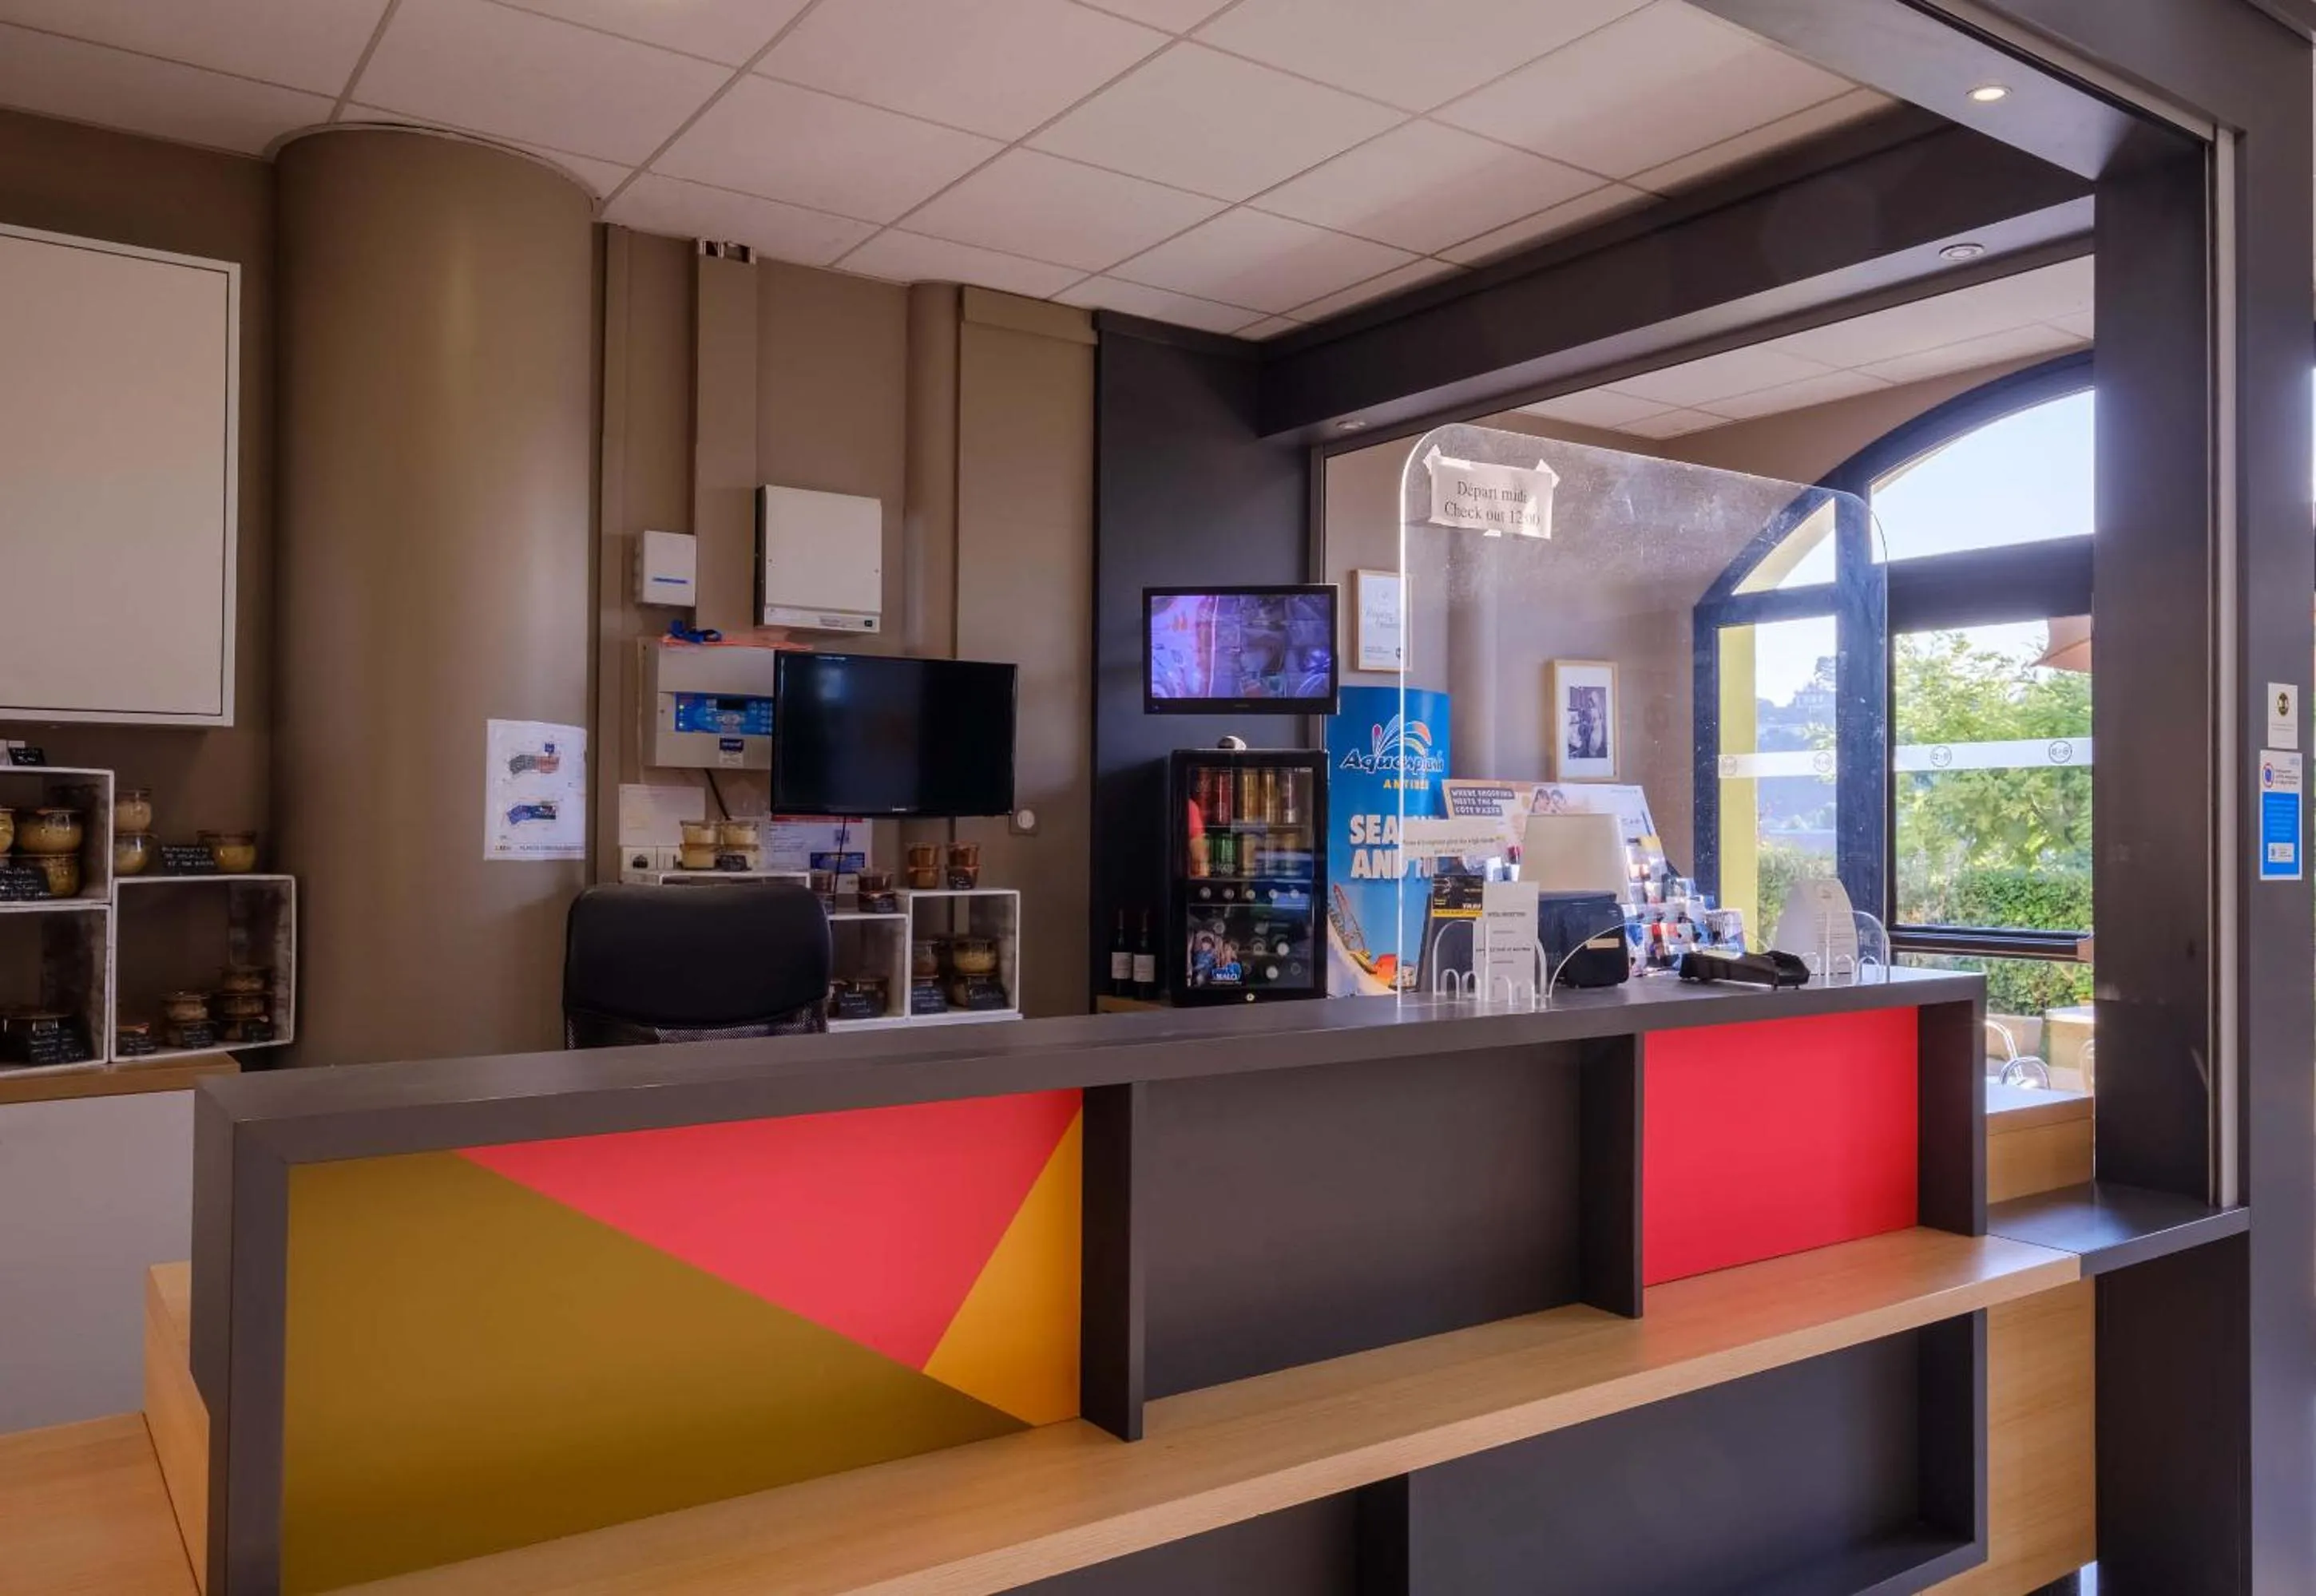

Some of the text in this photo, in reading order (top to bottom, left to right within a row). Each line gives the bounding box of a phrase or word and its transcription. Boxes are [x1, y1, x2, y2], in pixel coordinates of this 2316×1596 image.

[1444, 500, 1482, 520] Check
[1486, 509, 1505, 525] out
[1350, 814, 1399, 845] SEA
